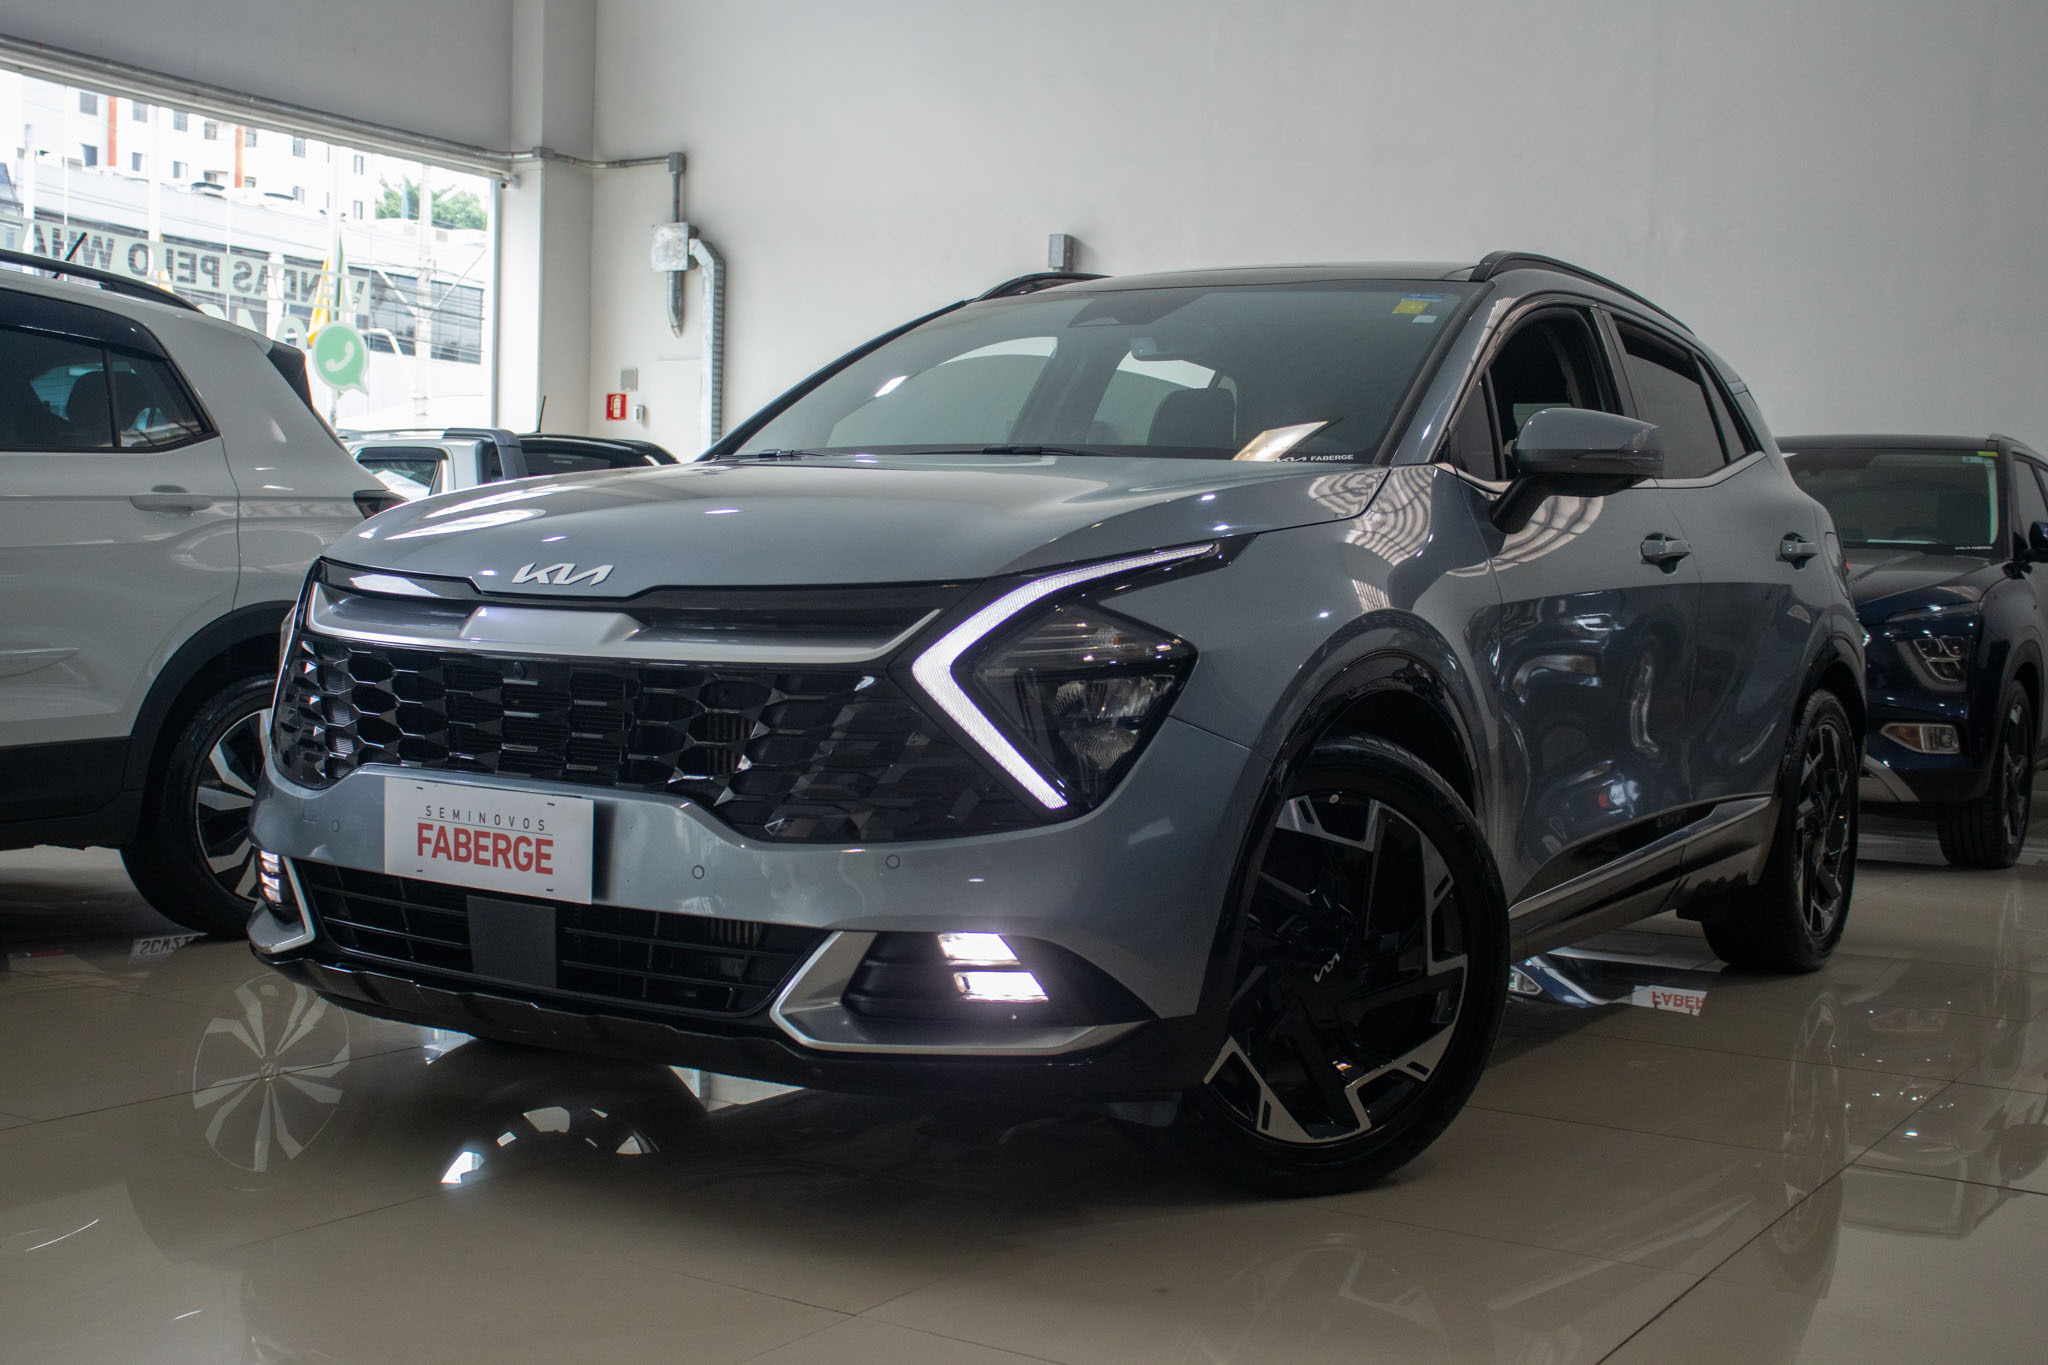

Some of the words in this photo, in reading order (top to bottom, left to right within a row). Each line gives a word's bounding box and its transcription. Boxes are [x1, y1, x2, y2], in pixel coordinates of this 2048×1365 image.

[1310, 454, 1354, 462] FABERGE
[511, 562, 614, 586] KIA
[426, 806, 545, 831] SEMINOVOS
[417, 822, 554, 875] FABERGE
